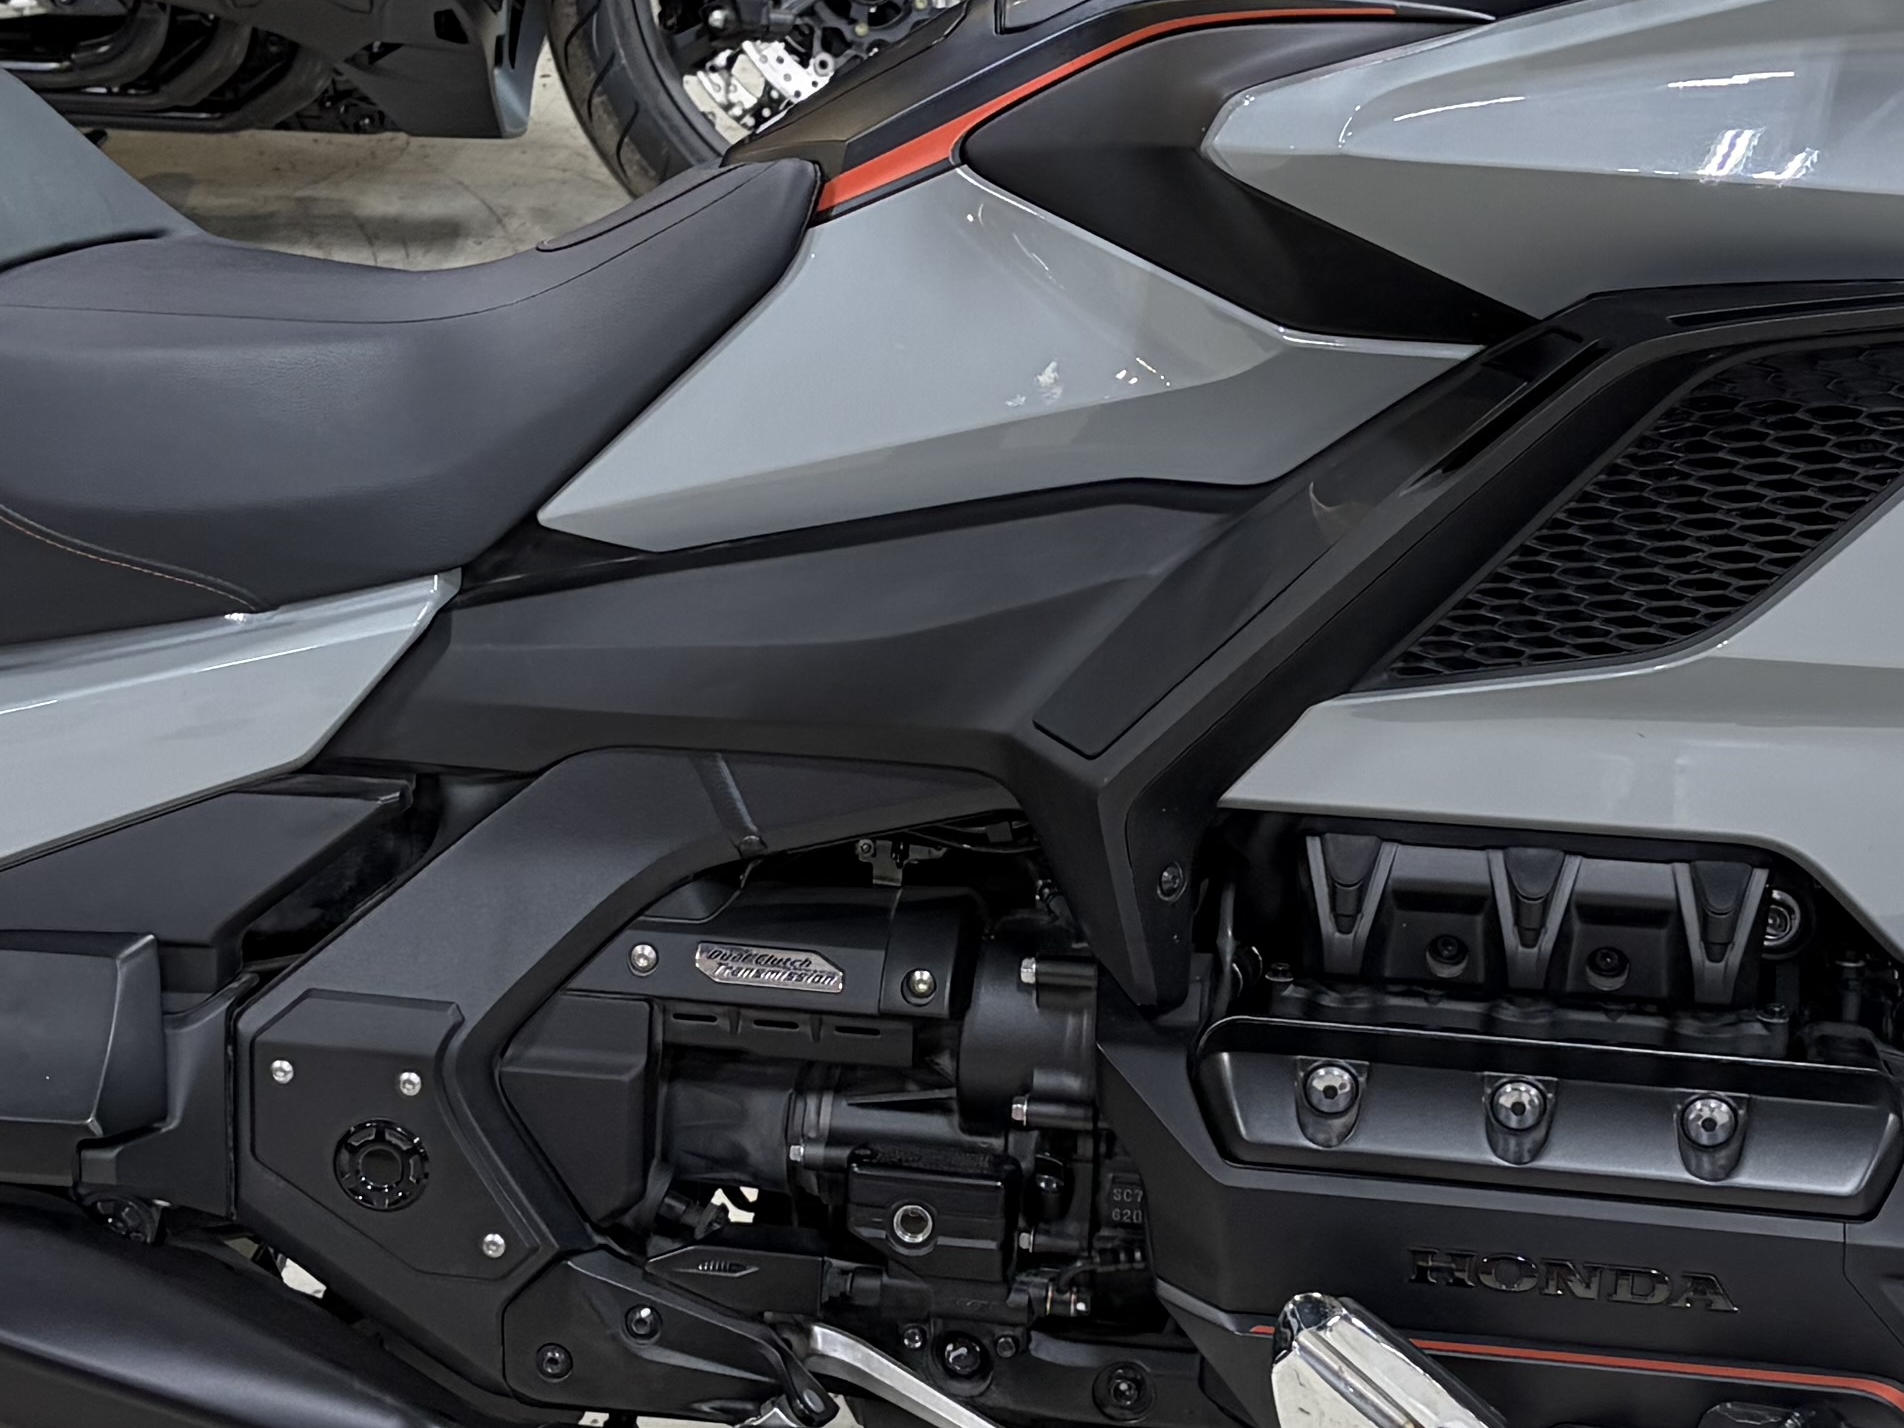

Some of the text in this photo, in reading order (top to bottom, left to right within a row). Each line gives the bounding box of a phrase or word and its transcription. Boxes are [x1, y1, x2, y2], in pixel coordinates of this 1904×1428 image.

[706, 948, 813, 968] Dual Clutch
[715, 961, 839, 985] Transmission
[1406, 1246, 1741, 1313] HONDA
